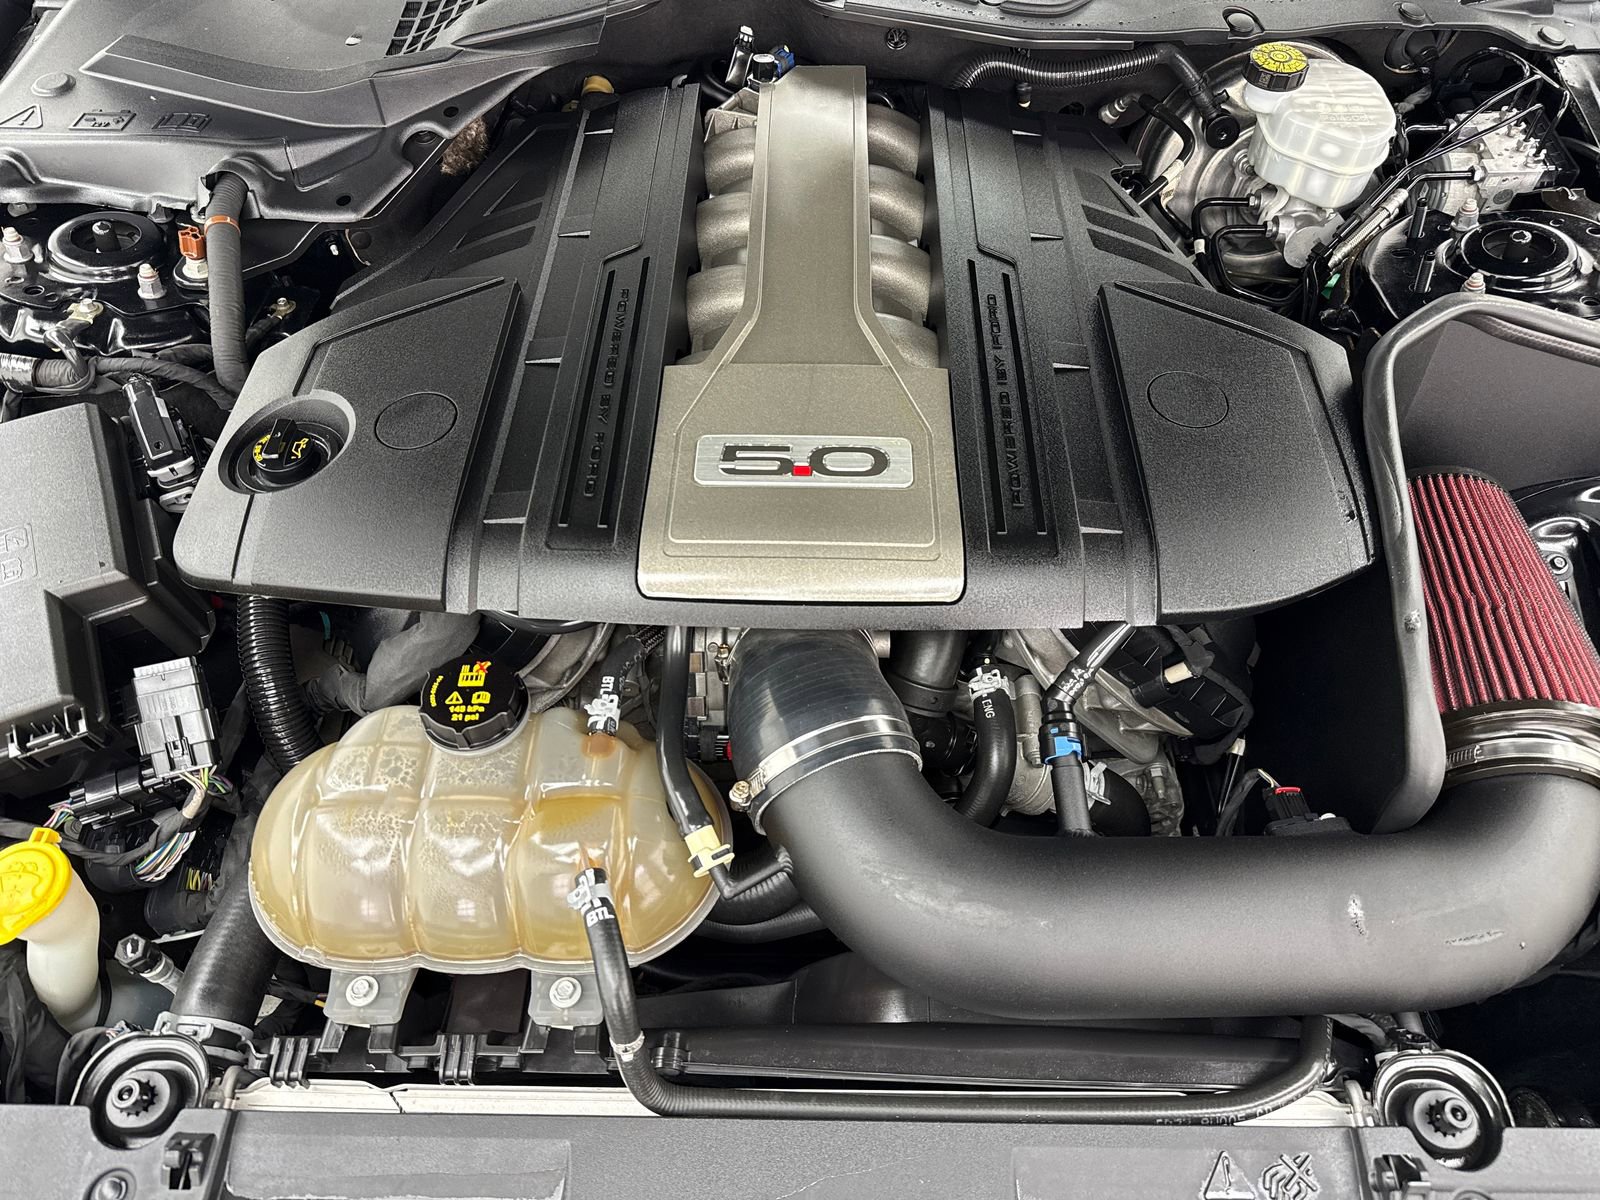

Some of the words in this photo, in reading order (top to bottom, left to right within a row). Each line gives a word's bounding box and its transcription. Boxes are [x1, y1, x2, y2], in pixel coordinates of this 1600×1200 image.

[603, 288, 630, 387] POWERED
[986, 293, 1003, 350] FORD
[993, 355, 1008, 386] BY
[599, 393, 611, 425] BY
[583, 432, 605, 497] FORD
[718, 443, 891, 478] 5.0
[1000, 391, 1025, 509] POWERED
[600, 675, 615, 695] BTL
[450, 713, 463, 721] 21
[982, 698, 996, 719] ENG
[585, 906, 615, 928] BTL
